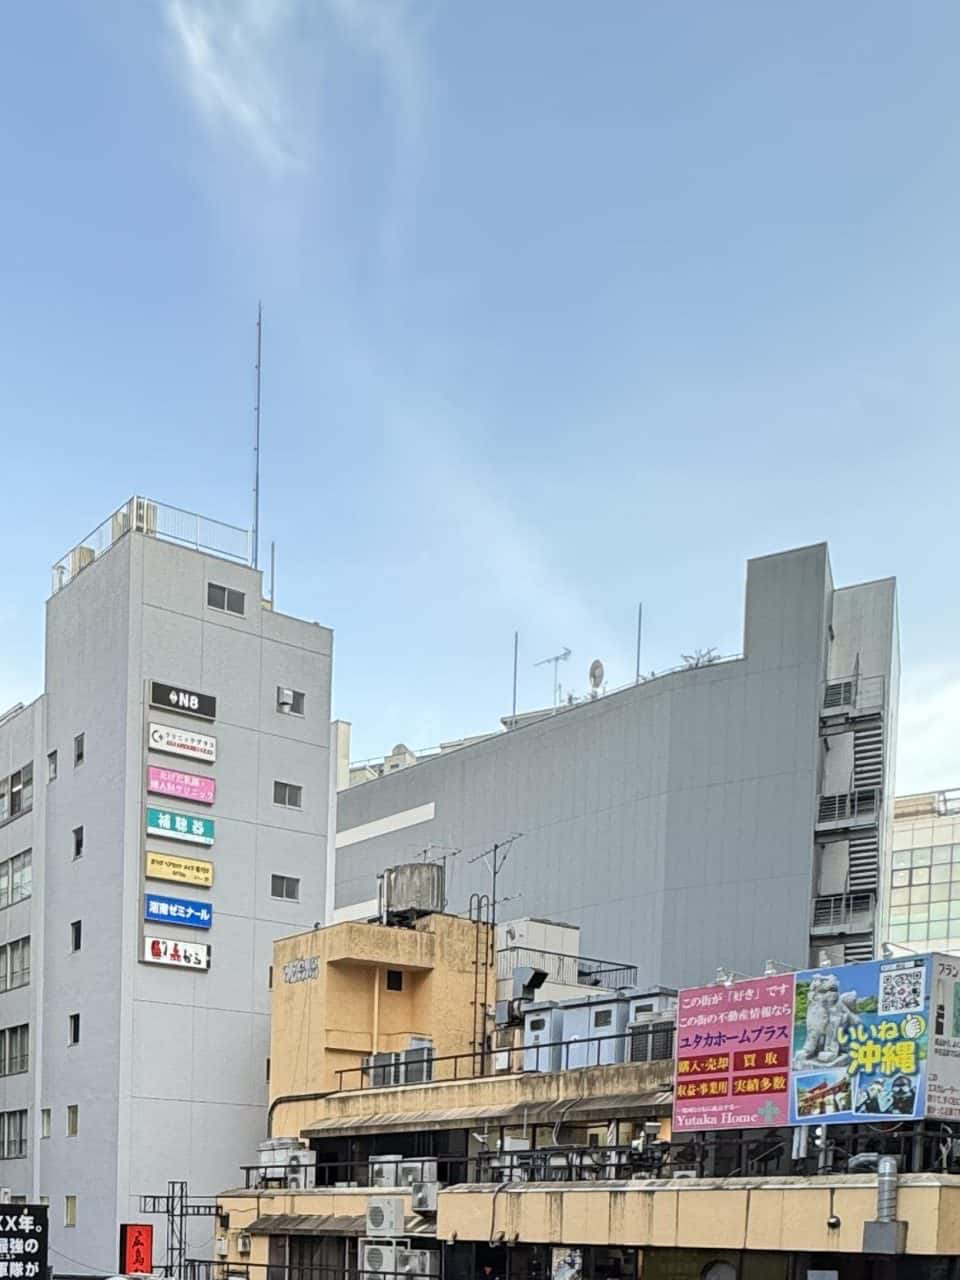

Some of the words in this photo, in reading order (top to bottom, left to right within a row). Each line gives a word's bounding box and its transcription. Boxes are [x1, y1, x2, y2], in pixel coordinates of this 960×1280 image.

[837, 1020, 898, 1045] いいね
[848, 1041, 917, 1075] 沖縄
[676, 1113, 718, 1127] Yutaka
[721, 1111, 759, 1123] Home
